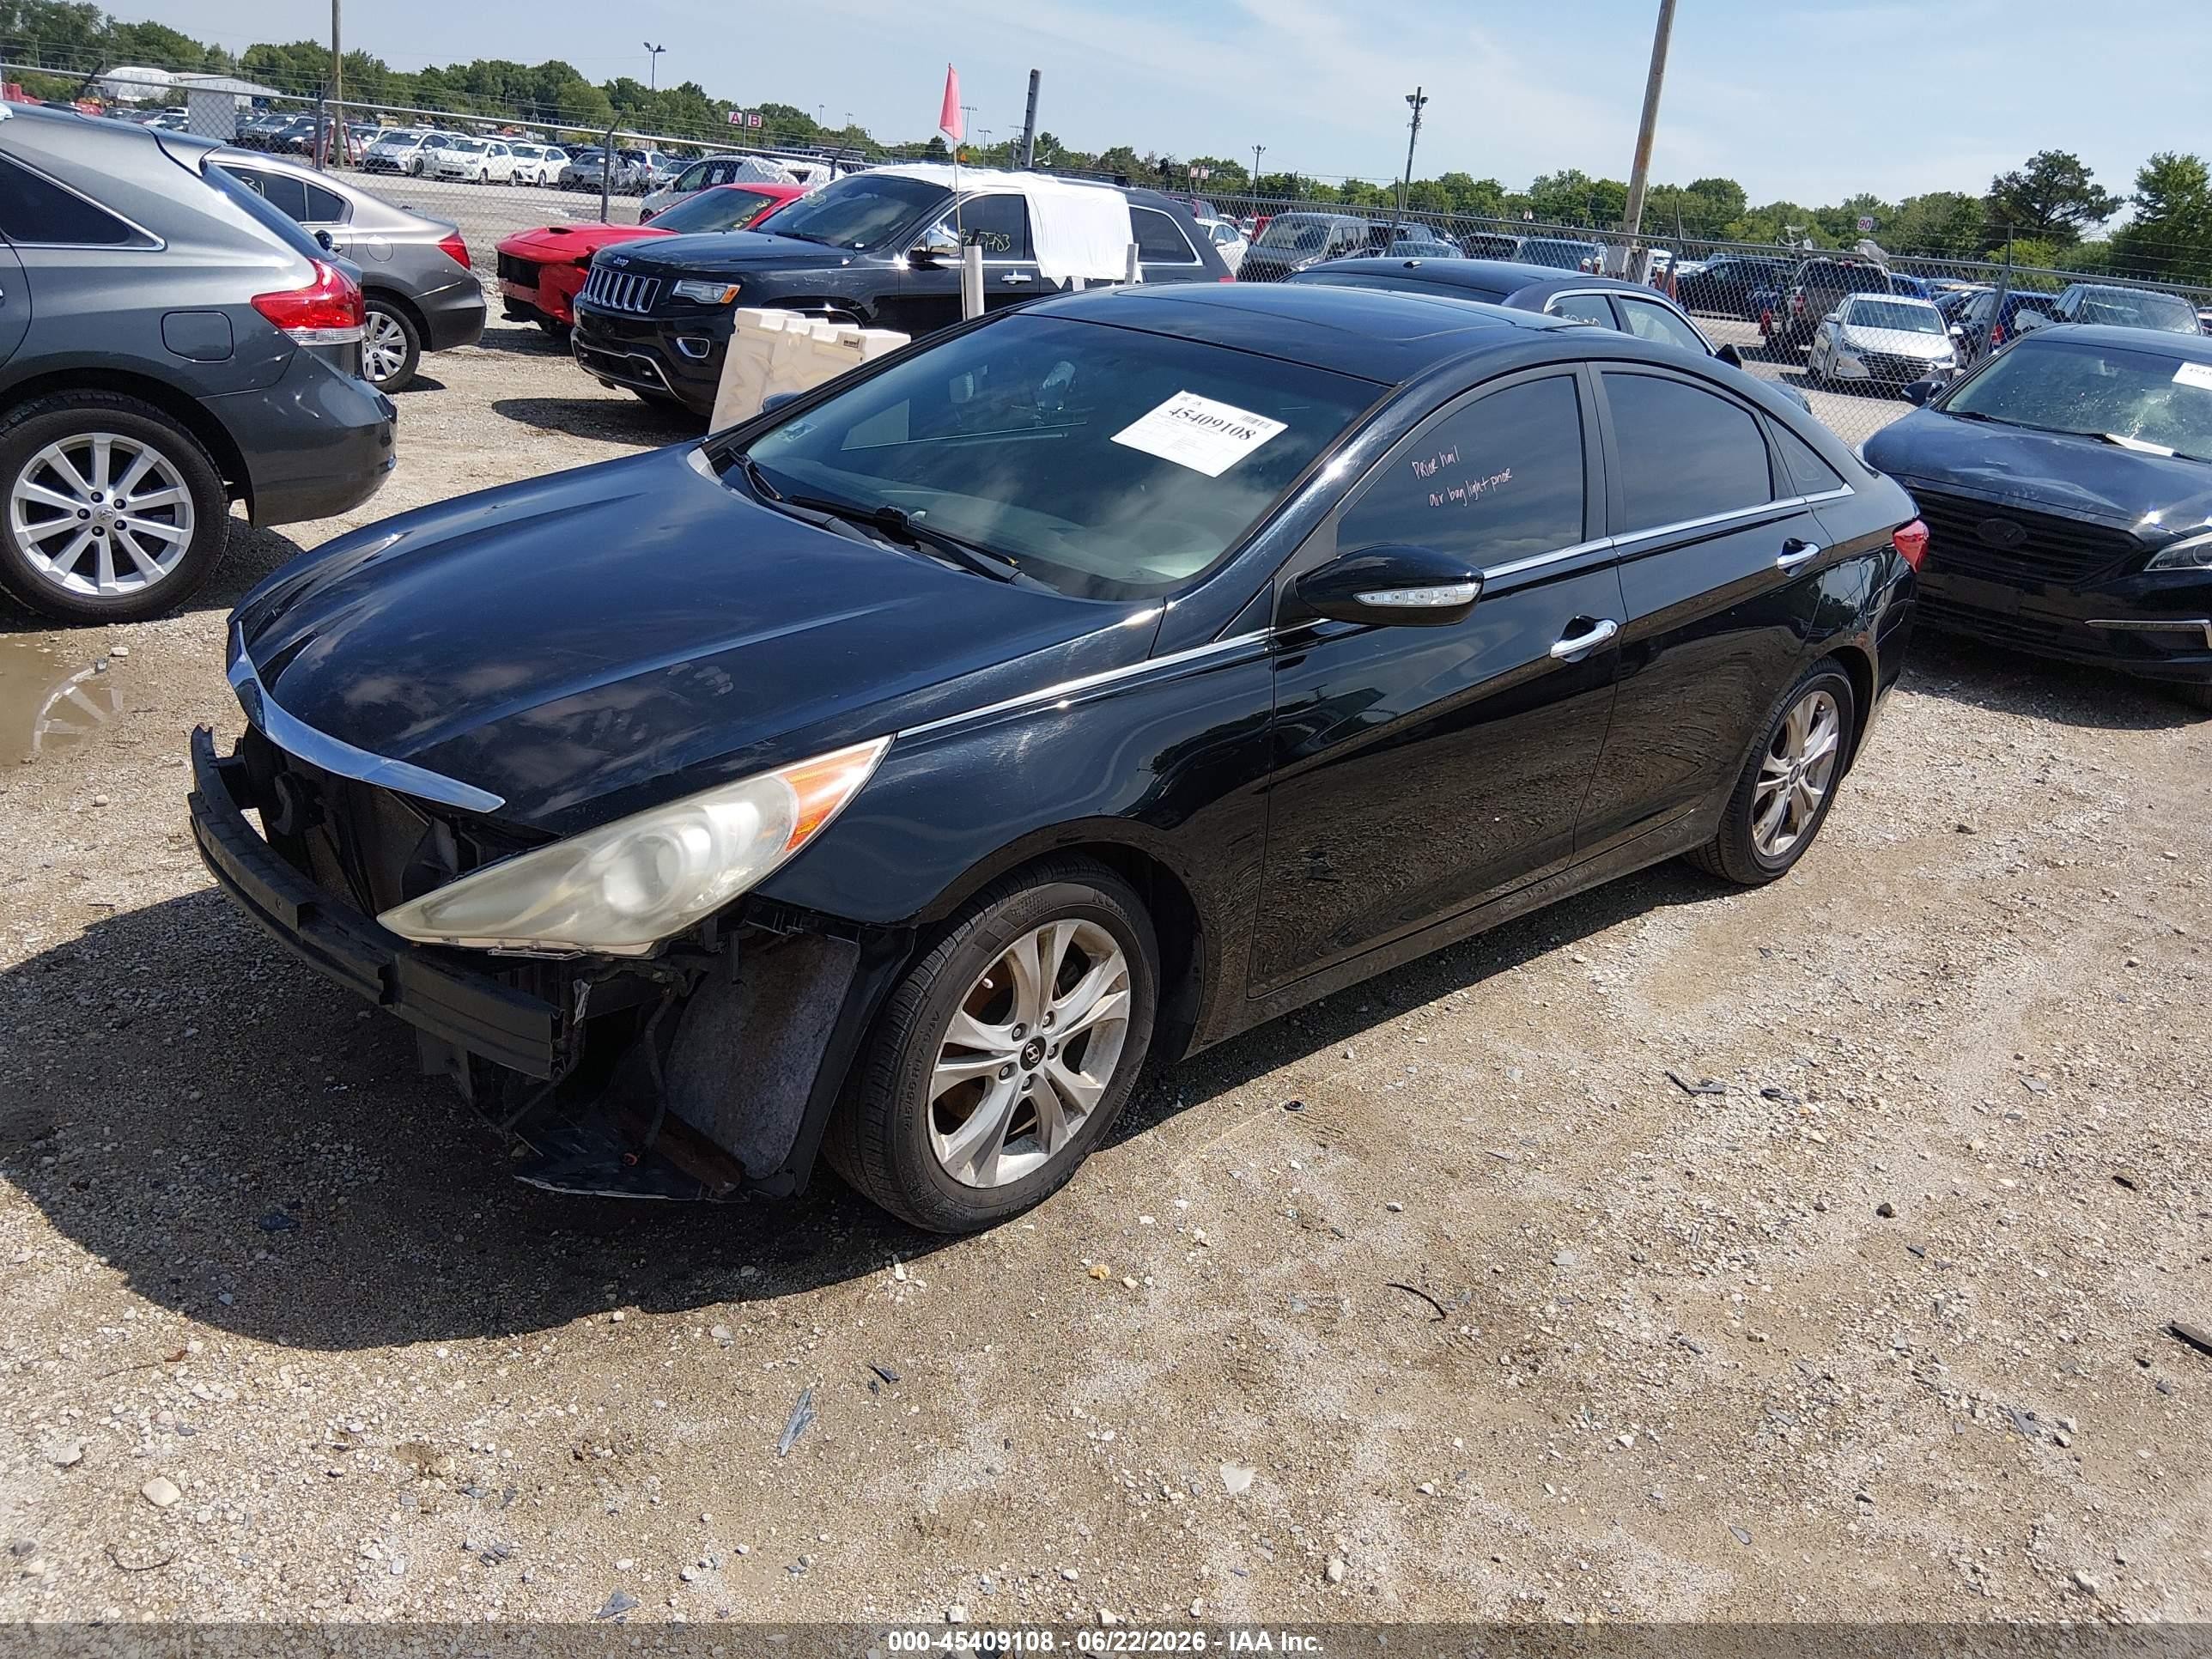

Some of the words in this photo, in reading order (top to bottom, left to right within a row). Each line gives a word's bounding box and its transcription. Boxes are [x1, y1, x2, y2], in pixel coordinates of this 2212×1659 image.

[731, 112, 740, 124] A
[750, 115, 760, 126] B
[1858, 219, 1872, 229] 90
[1168, 407, 1257, 441] 45409108
[1438, 445, 1460, 468] hail
[1429, 492, 1444, 507] air
[1446, 487, 1468, 507] bag
[1465, 476, 1491, 501] light
